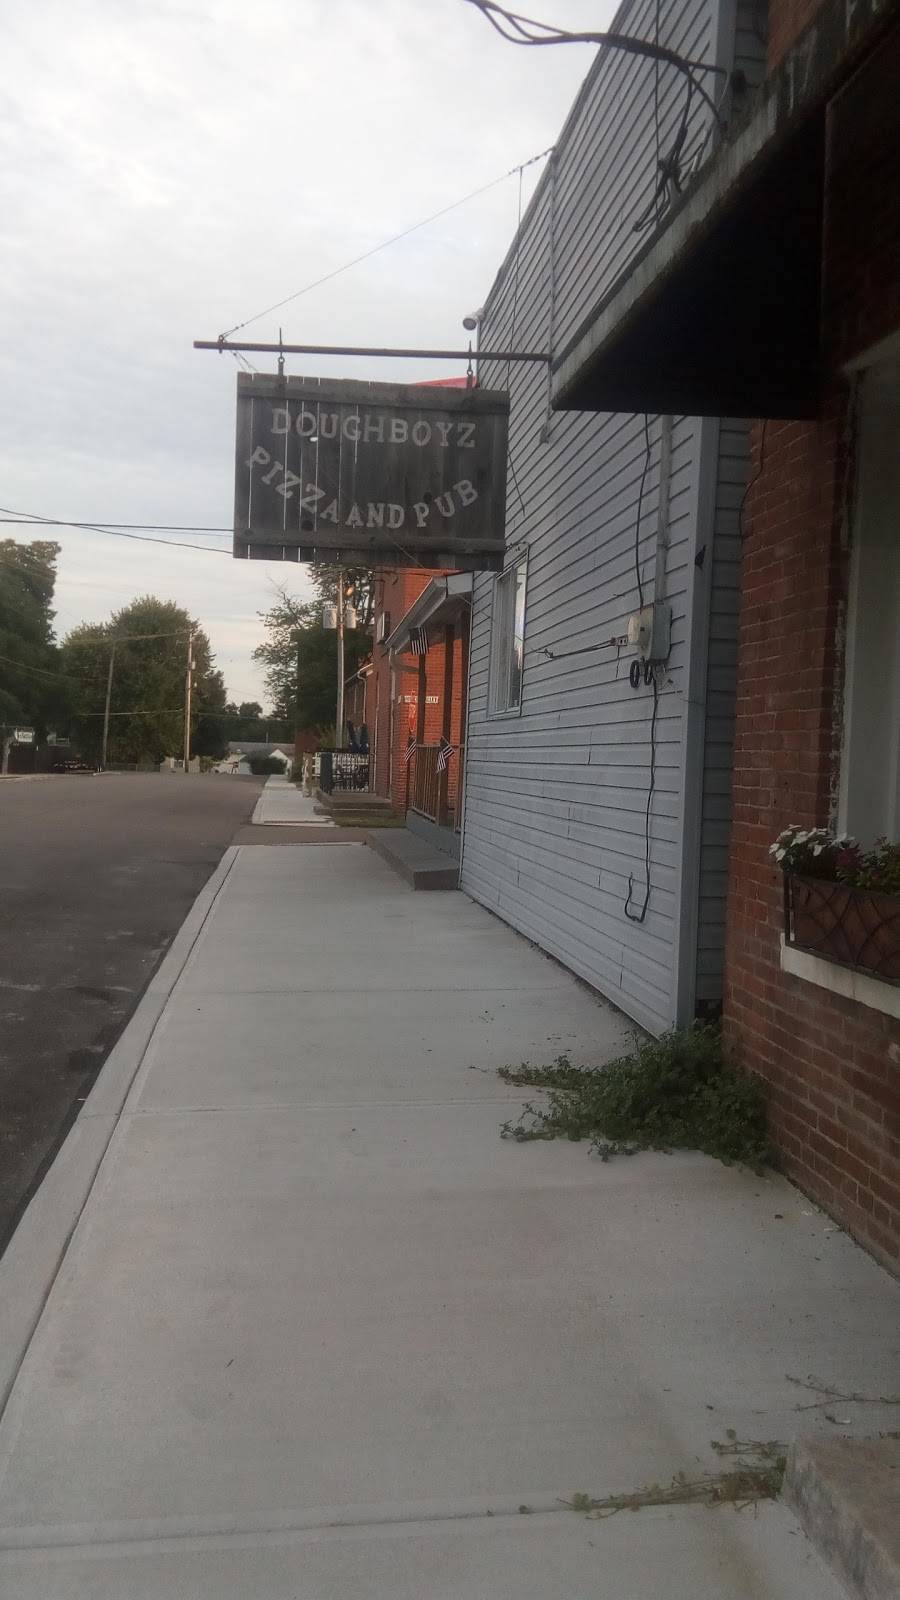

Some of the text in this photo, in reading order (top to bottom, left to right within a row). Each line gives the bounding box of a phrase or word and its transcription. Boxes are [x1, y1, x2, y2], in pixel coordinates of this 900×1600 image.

[271, 408, 476, 447] DOUGHBOYZ
[246, 446, 479, 528] PIZZA AND PUB
